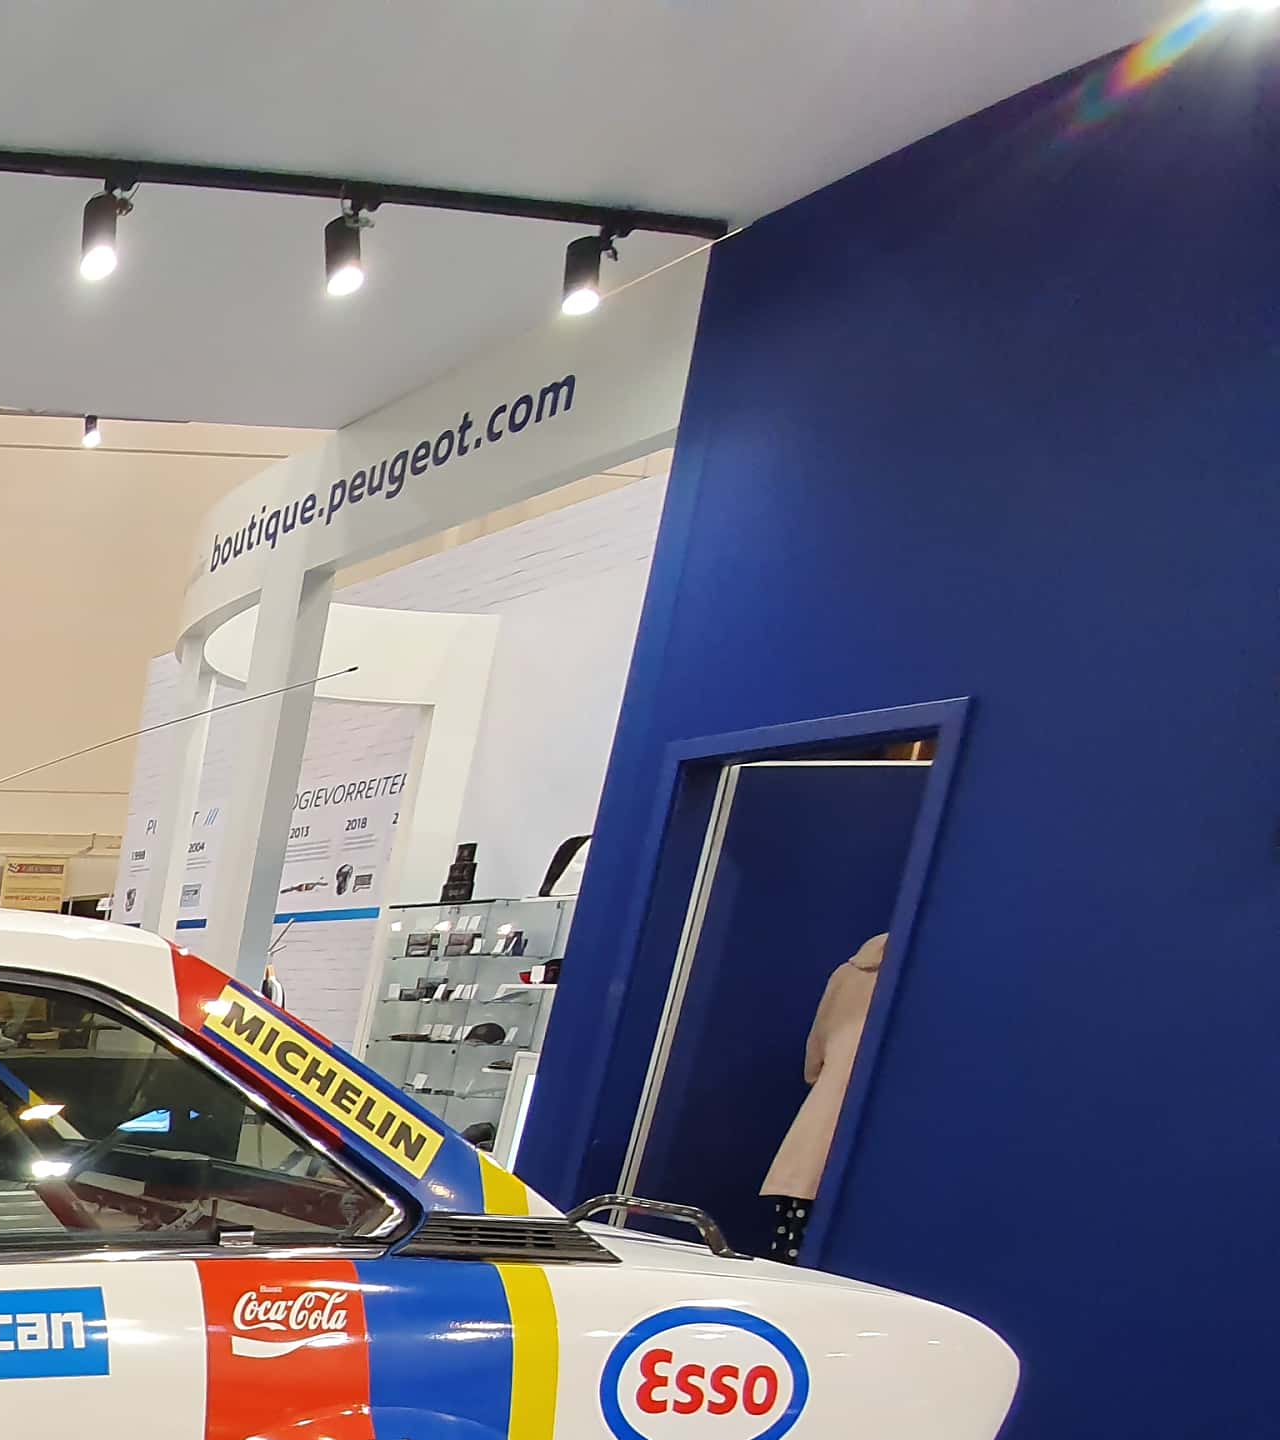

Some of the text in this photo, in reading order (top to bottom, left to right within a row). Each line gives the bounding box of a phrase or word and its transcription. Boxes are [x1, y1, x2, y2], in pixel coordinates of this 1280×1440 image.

[210, 373, 576, 573] boutique.peugeot.com
[345, 817, 368, 831] 2018
[220, 1001, 428, 1163] MICHELIN
[233, 1290, 349, 1331] Coca-Cola
